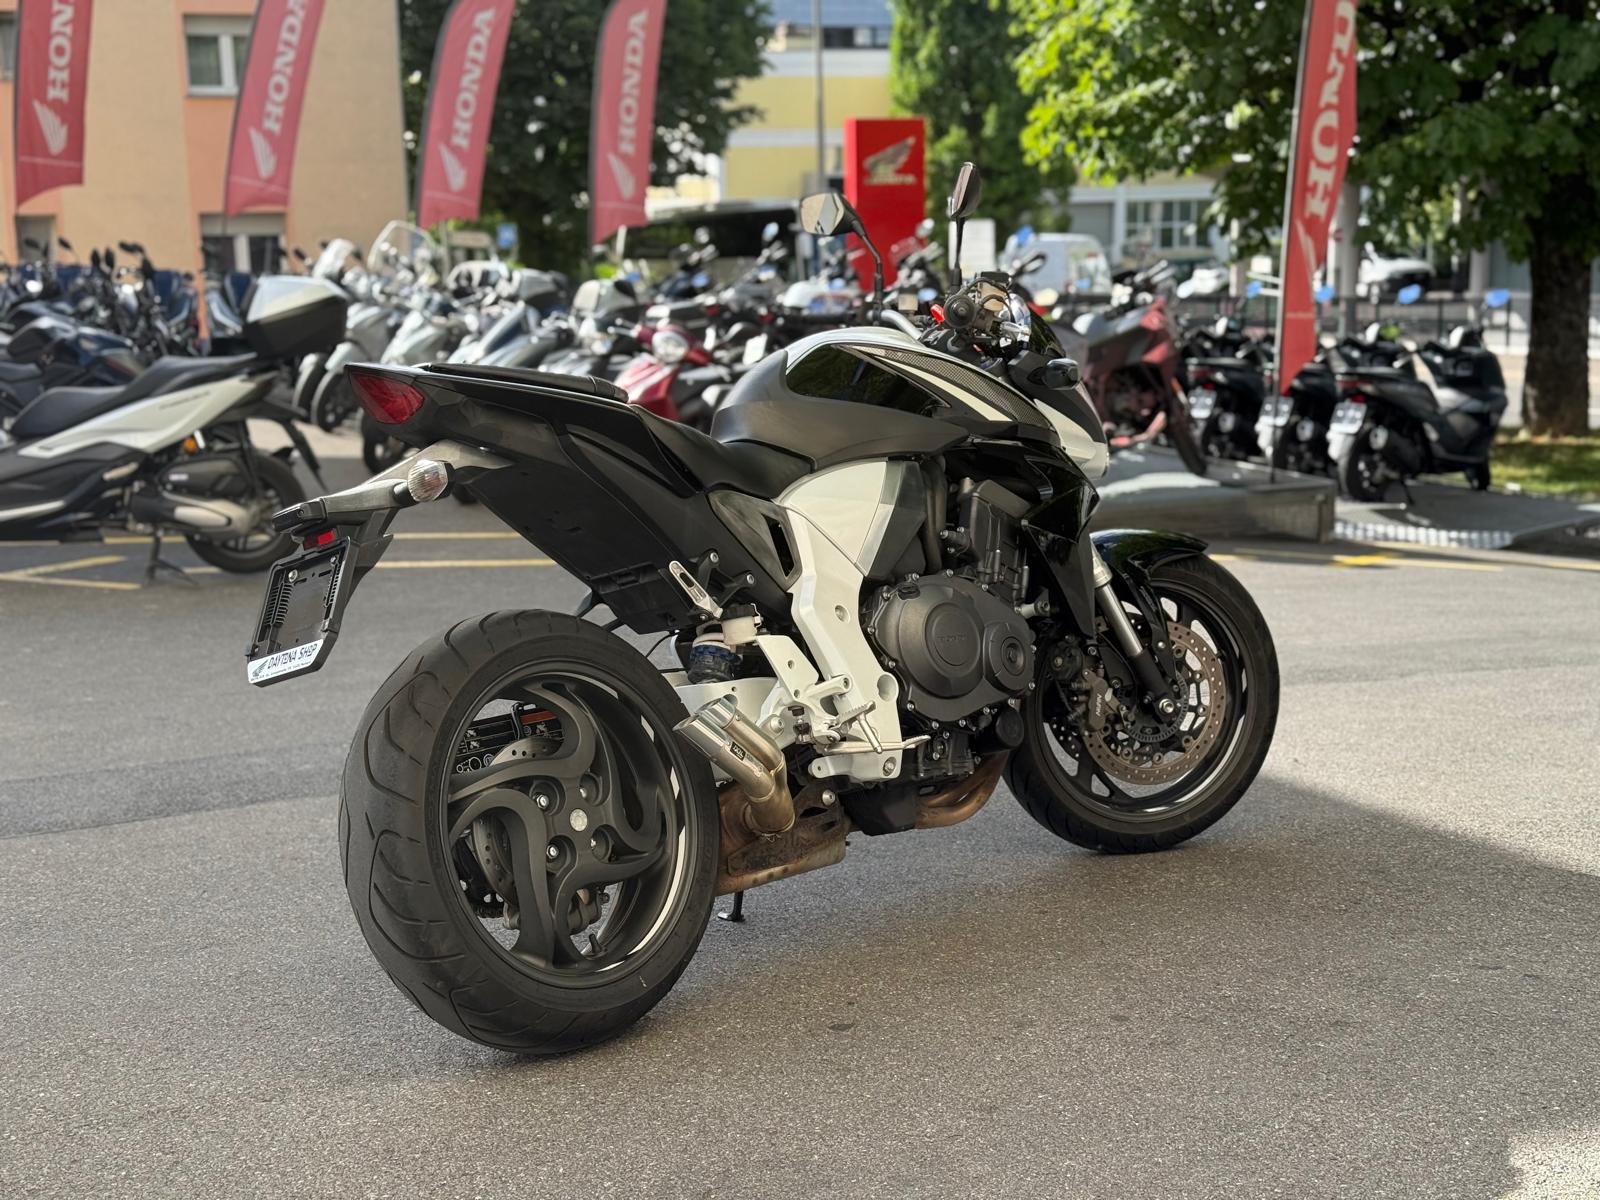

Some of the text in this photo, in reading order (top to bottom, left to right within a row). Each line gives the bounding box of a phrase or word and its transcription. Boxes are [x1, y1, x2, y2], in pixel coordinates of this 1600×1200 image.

[47, 0, 74, 103] HON
[452, 7, 496, 150] HONDA
[618, 9, 650, 156] HONDA
[267, 643, 318, 669] DAYTONA SHOP
